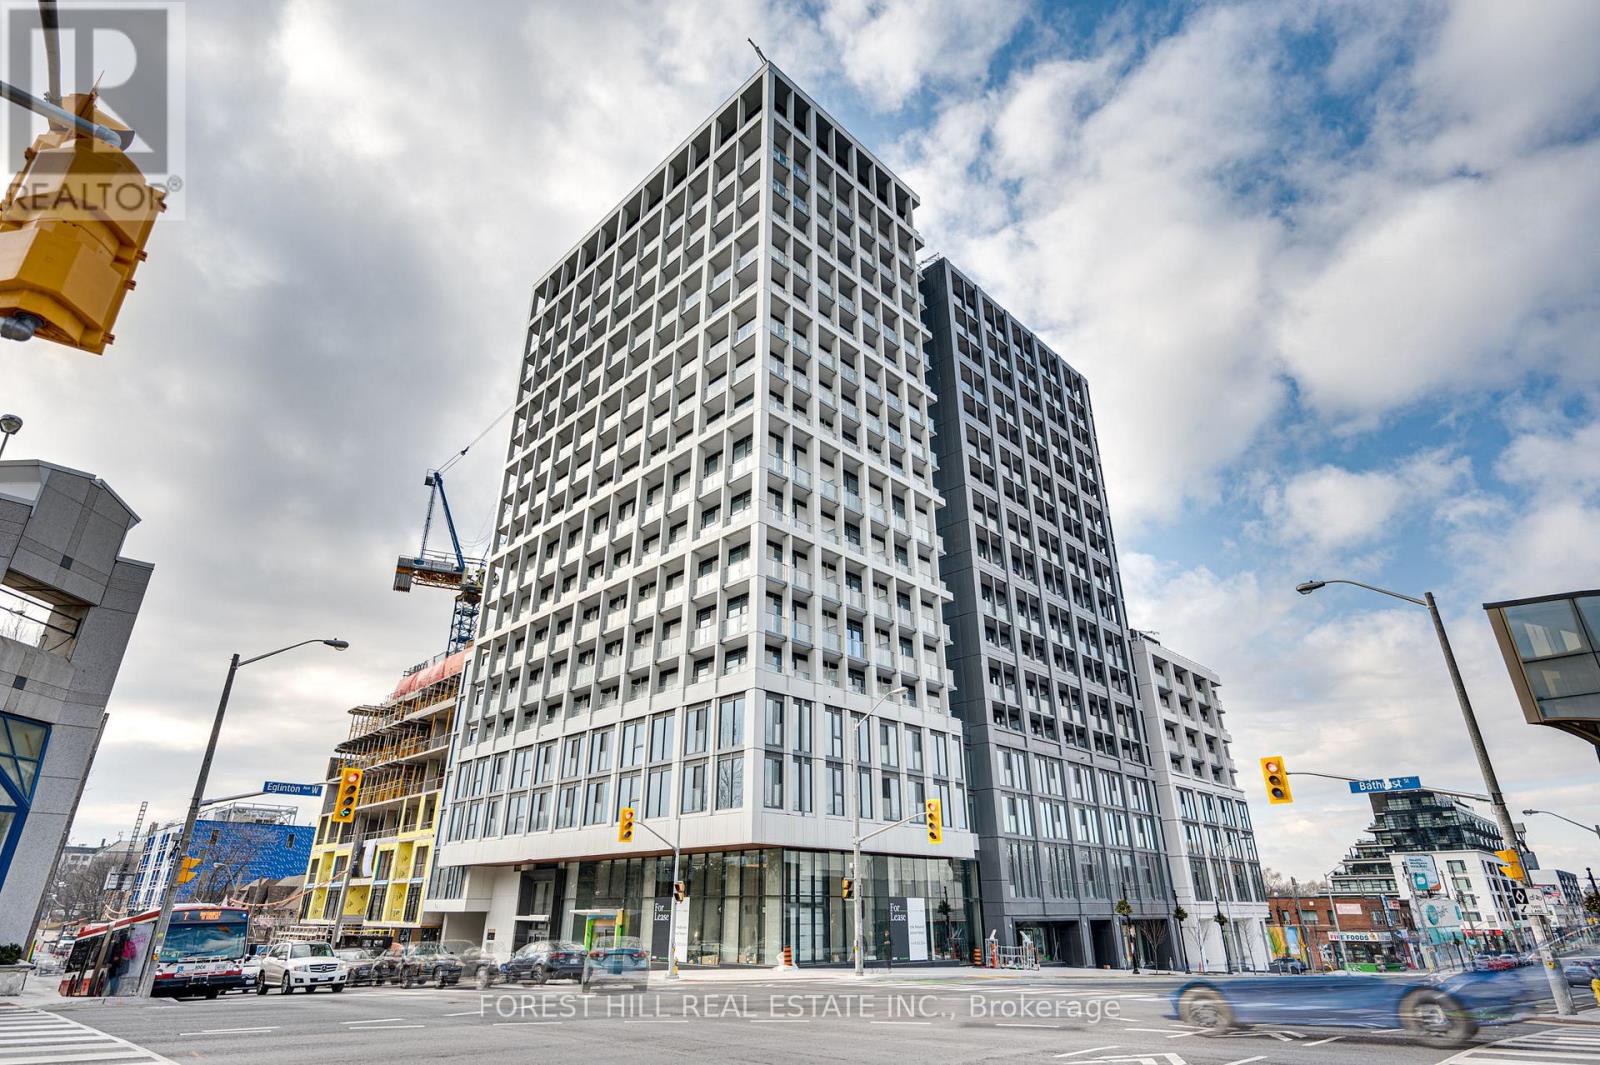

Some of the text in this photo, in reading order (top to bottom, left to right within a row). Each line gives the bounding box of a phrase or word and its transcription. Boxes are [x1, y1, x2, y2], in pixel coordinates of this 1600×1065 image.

[267, 782, 301, 793] Eglinton
[311, 785, 320, 794] W
[1359, 779, 1402, 791] Bathst
[654, 903, 665, 912] For
[889, 903, 900, 912] For
[183, 912, 190, 920] 7
[654, 912, 670, 921] Lease
[890, 913, 907, 921] Lease
